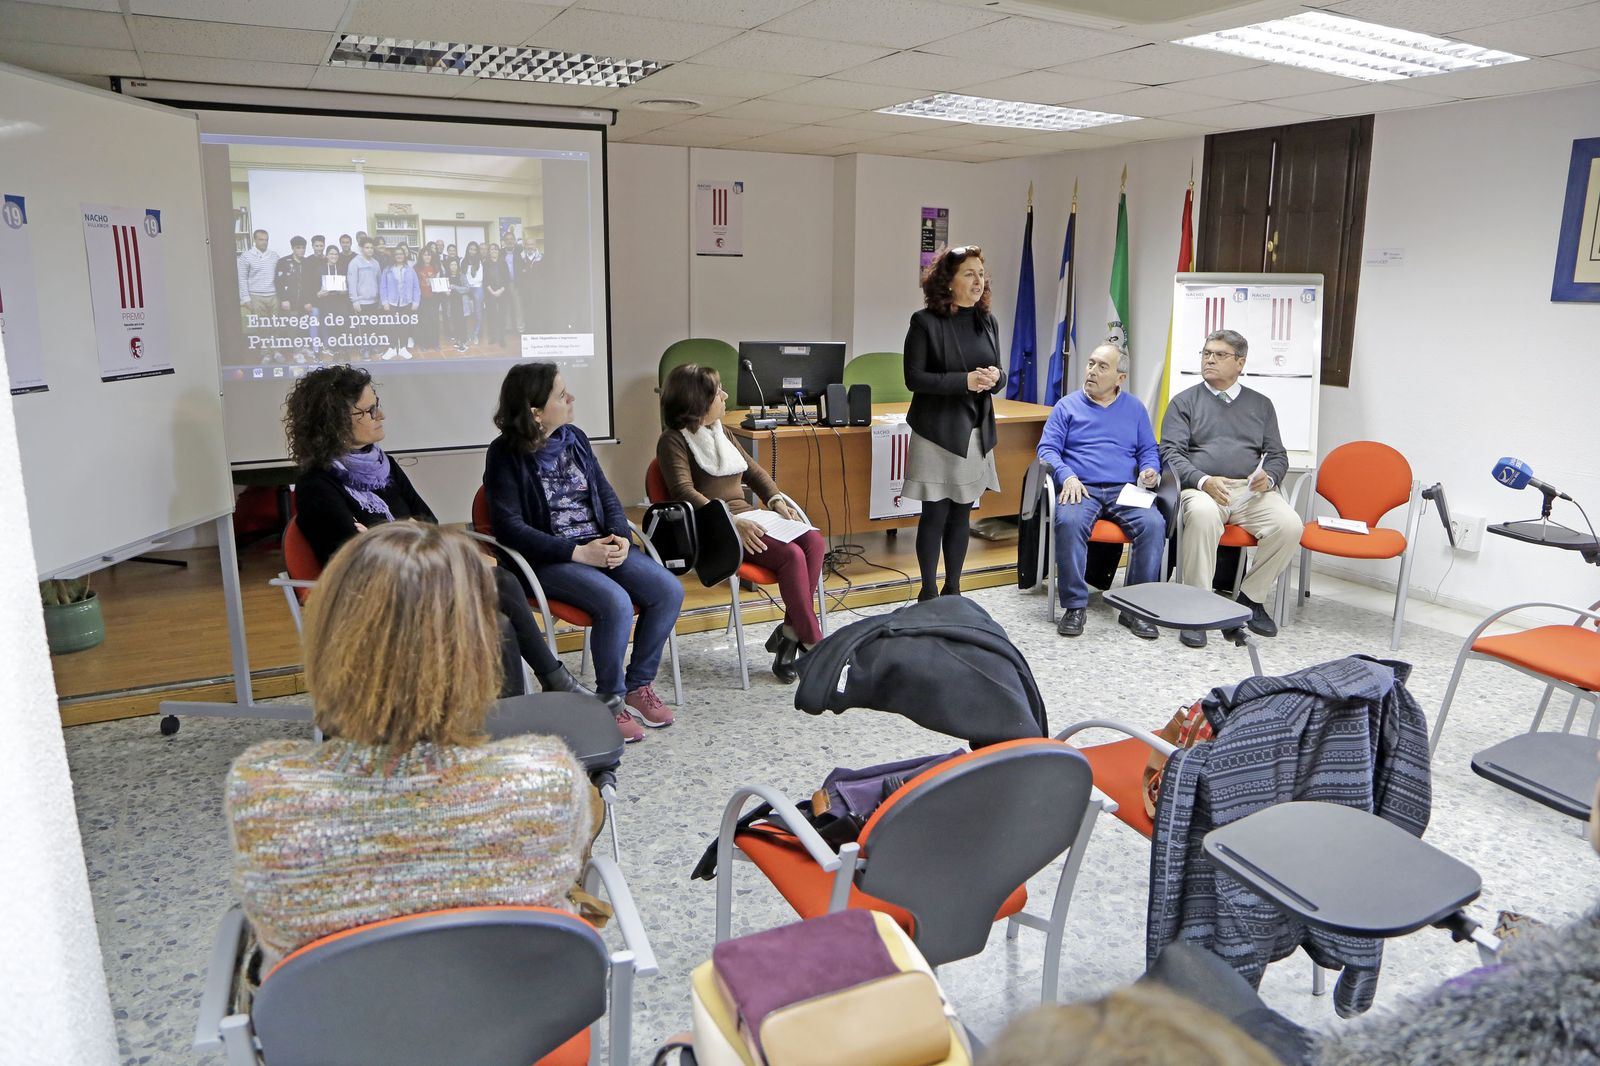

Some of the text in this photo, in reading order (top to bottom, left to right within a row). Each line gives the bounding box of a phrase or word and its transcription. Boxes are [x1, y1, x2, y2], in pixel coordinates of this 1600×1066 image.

[4, 206, 22, 226] 19
[84, 213, 109, 223] NACHO
[145, 217, 158, 236] 19
[1302, 292, 1312, 302] 19
[122, 312, 145, 320] PREMIO
[246, 312, 419, 330] Entrega de premios
[247, 332, 391, 349] Primera edición
